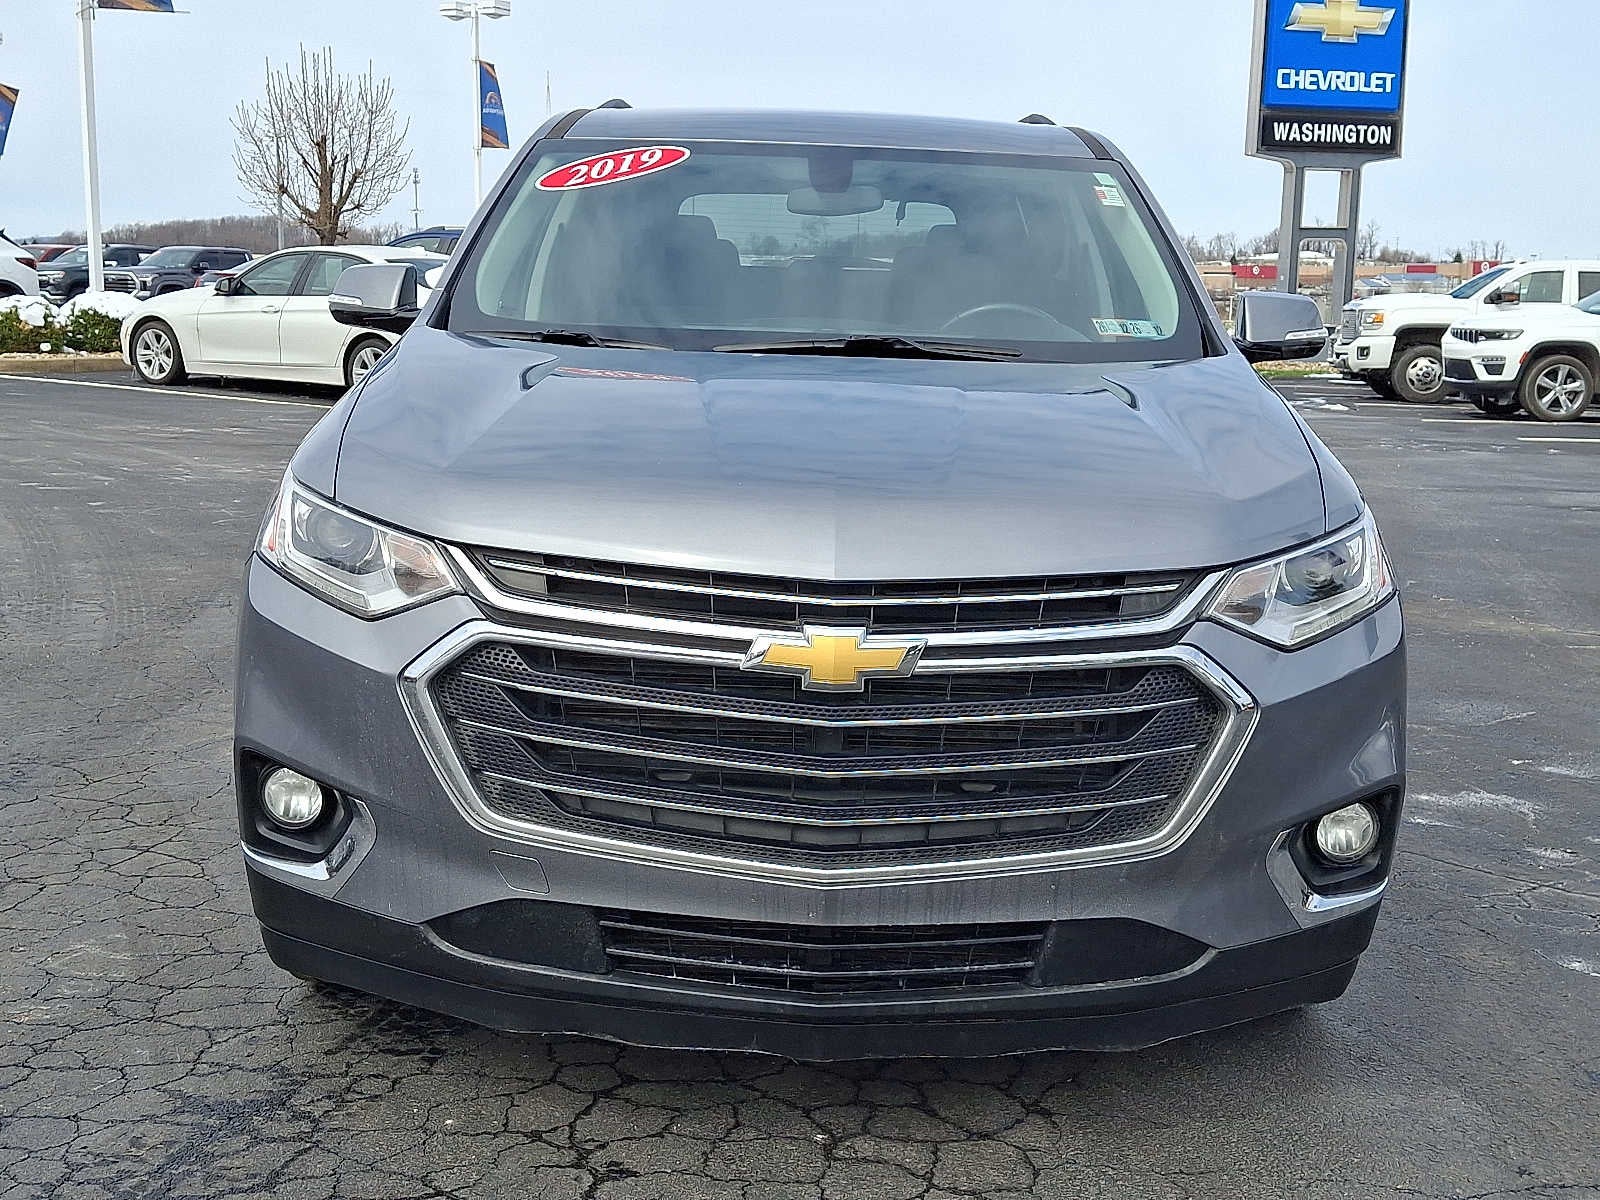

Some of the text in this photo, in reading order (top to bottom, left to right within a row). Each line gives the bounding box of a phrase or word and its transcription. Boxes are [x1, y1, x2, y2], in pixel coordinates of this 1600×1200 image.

[1276, 68, 1396, 93] CHEVROLET
[1273, 121, 1392, 145] WASHINGTON
[564, 148, 663, 187] 2019
